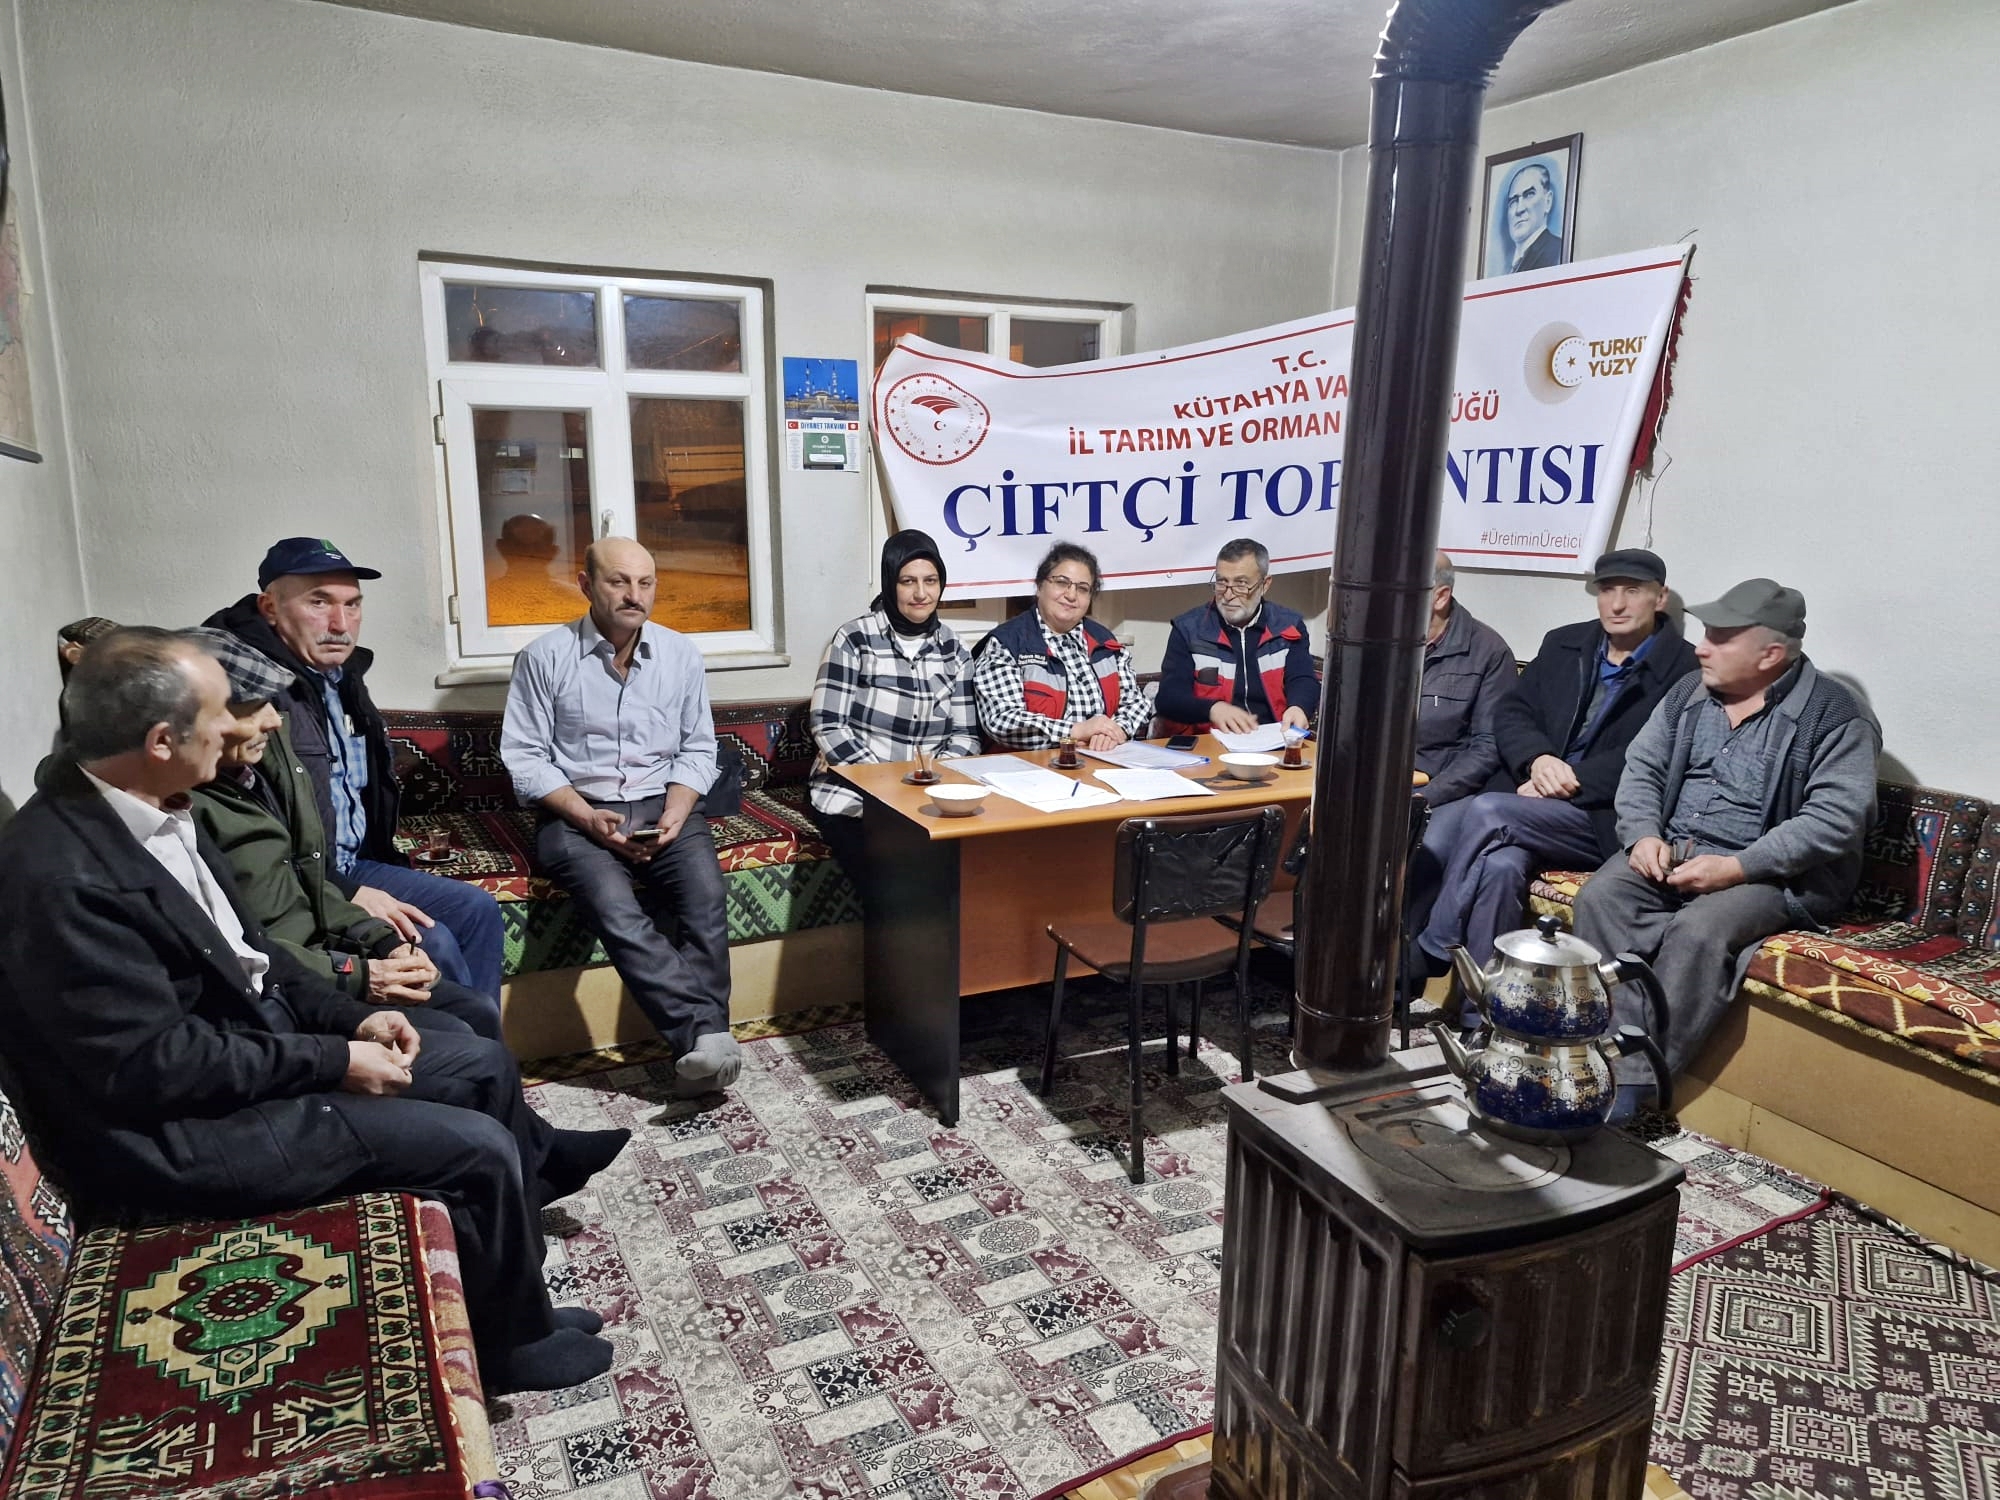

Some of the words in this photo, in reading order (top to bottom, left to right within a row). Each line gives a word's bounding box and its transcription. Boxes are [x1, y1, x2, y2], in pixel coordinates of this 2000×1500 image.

[1271, 350, 1328, 375] T.C.
[1173, 379, 1310, 419] KÜTAHYA
[1315, 374, 1350, 400] VA
[1069, 426, 1095, 455] İL
[1099, 427, 1193, 454] TARIM
[1197, 422, 1233, 448] VE
[1241, 410, 1341, 444] ORMAN
[943, 460, 1201, 552] ÇİFTÇİ
[1480, 528, 1583, 549] #ÜretiminÜretici
